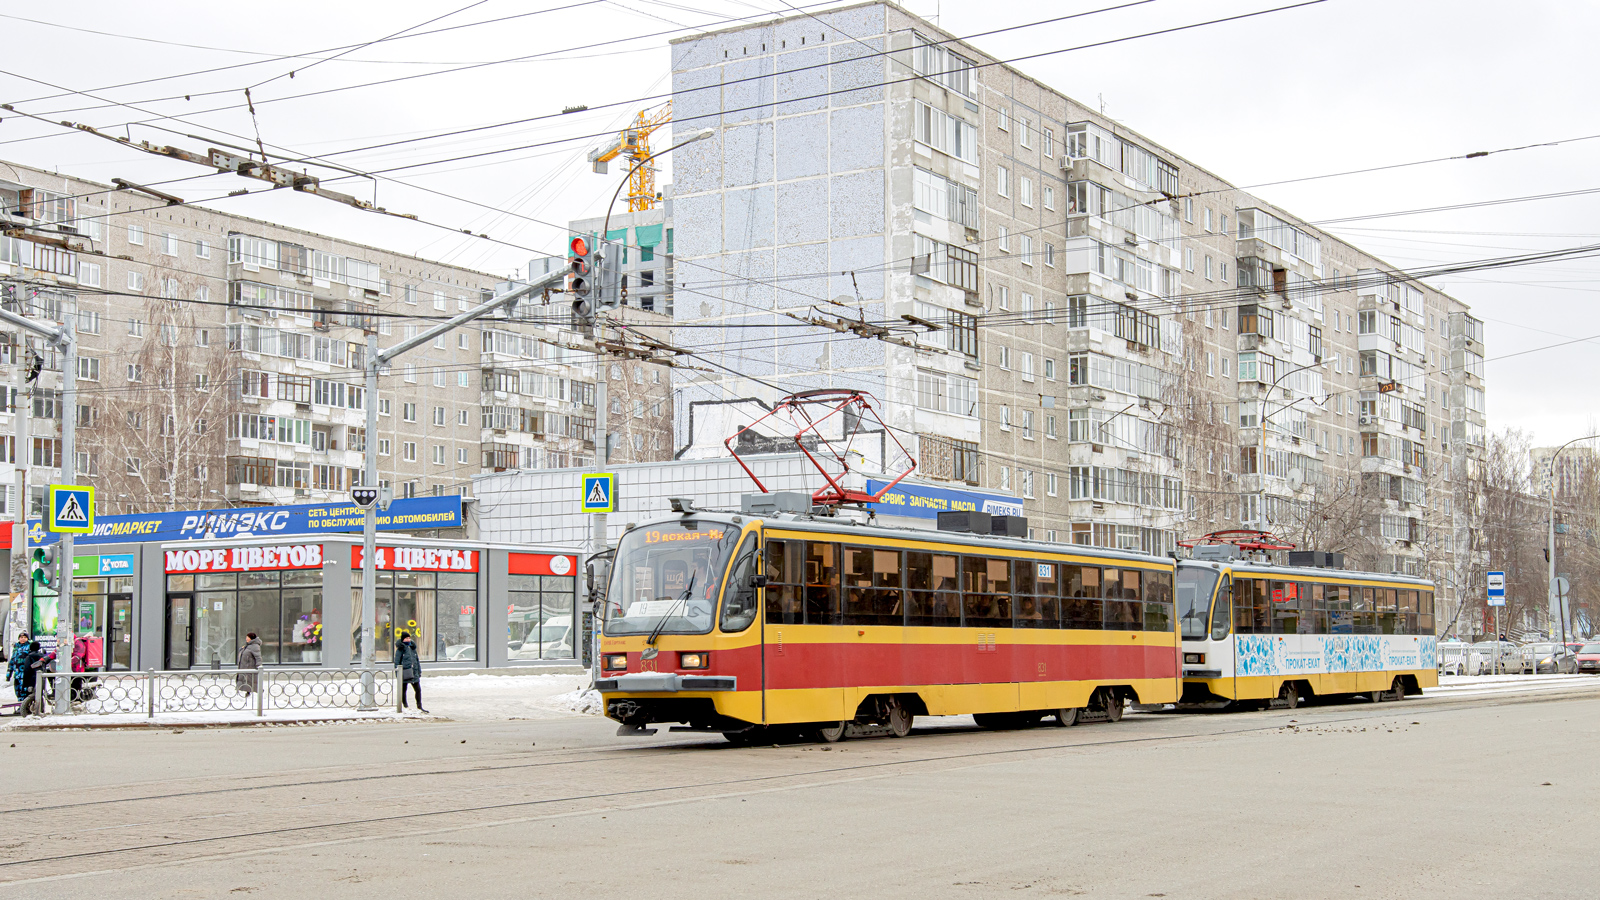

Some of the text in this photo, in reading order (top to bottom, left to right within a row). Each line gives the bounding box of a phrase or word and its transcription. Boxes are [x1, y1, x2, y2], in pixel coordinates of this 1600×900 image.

[875, 491, 976, 512] ЕРВИС ЗАПЧАСТИ МАСЛА
[308, 508, 327, 517] СЕТЬ
[180, 511, 290, 535] РИМЭКС
[308, 511, 455, 528] ПО ОБСЛУЖИВИЮ АВТОМОБИЛЕЙ
[645, 530, 660, 543] 19
[165, 544, 322, 571] МОРЕ ЦВЕТОВ
[393, 547, 473, 571] ЦВЕТЫ
[110, 560, 129, 569] YOTA
[1038, 565, 1050, 577] 831
[641, 659, 658, 672] 831
[1038, 662, 1046, 673] 831
[1285, 657, 1321, 669] ПРОКАТ-ЕКАТ
